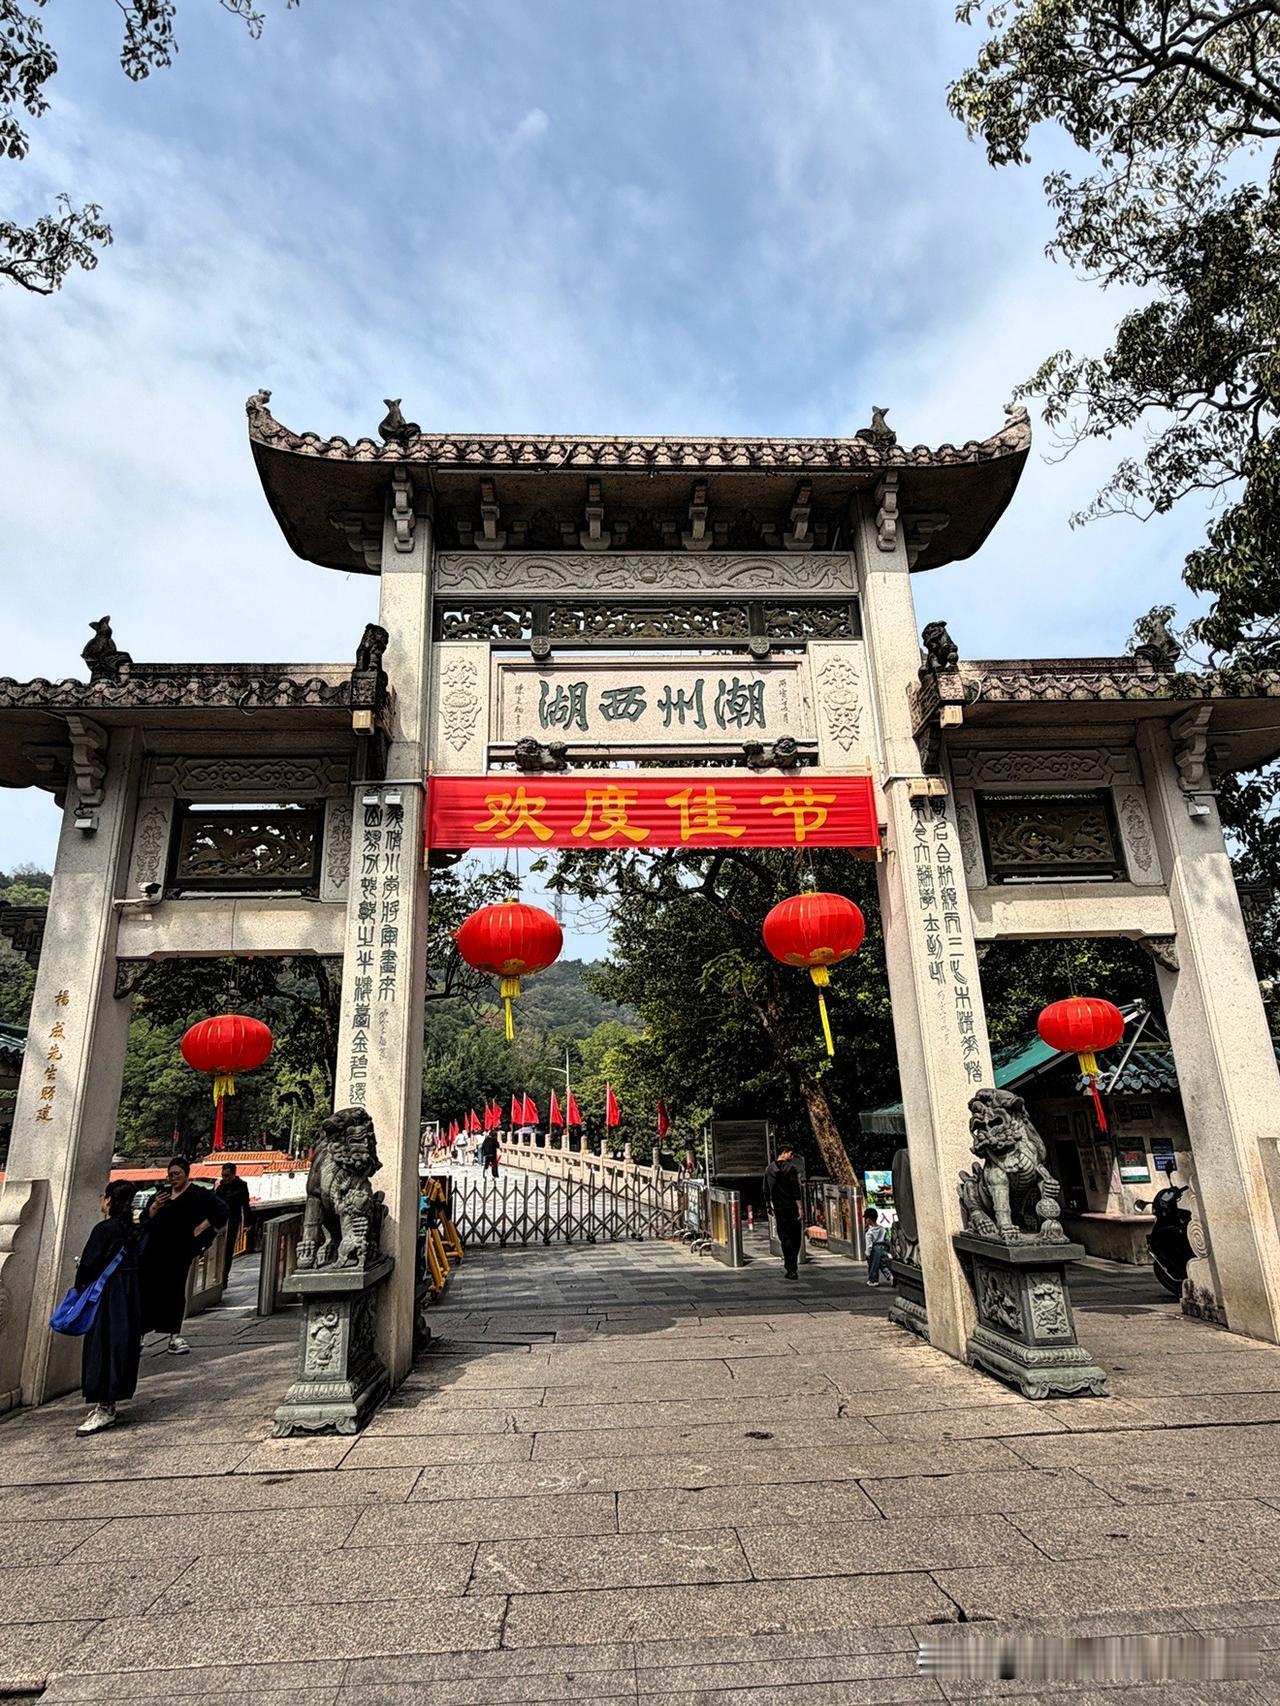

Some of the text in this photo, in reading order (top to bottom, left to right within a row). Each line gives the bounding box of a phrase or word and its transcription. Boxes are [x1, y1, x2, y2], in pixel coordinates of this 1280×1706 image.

[538, 677, 766, 732] 潮州西湖
[473, 784, 837, 842] 欢度佳节
